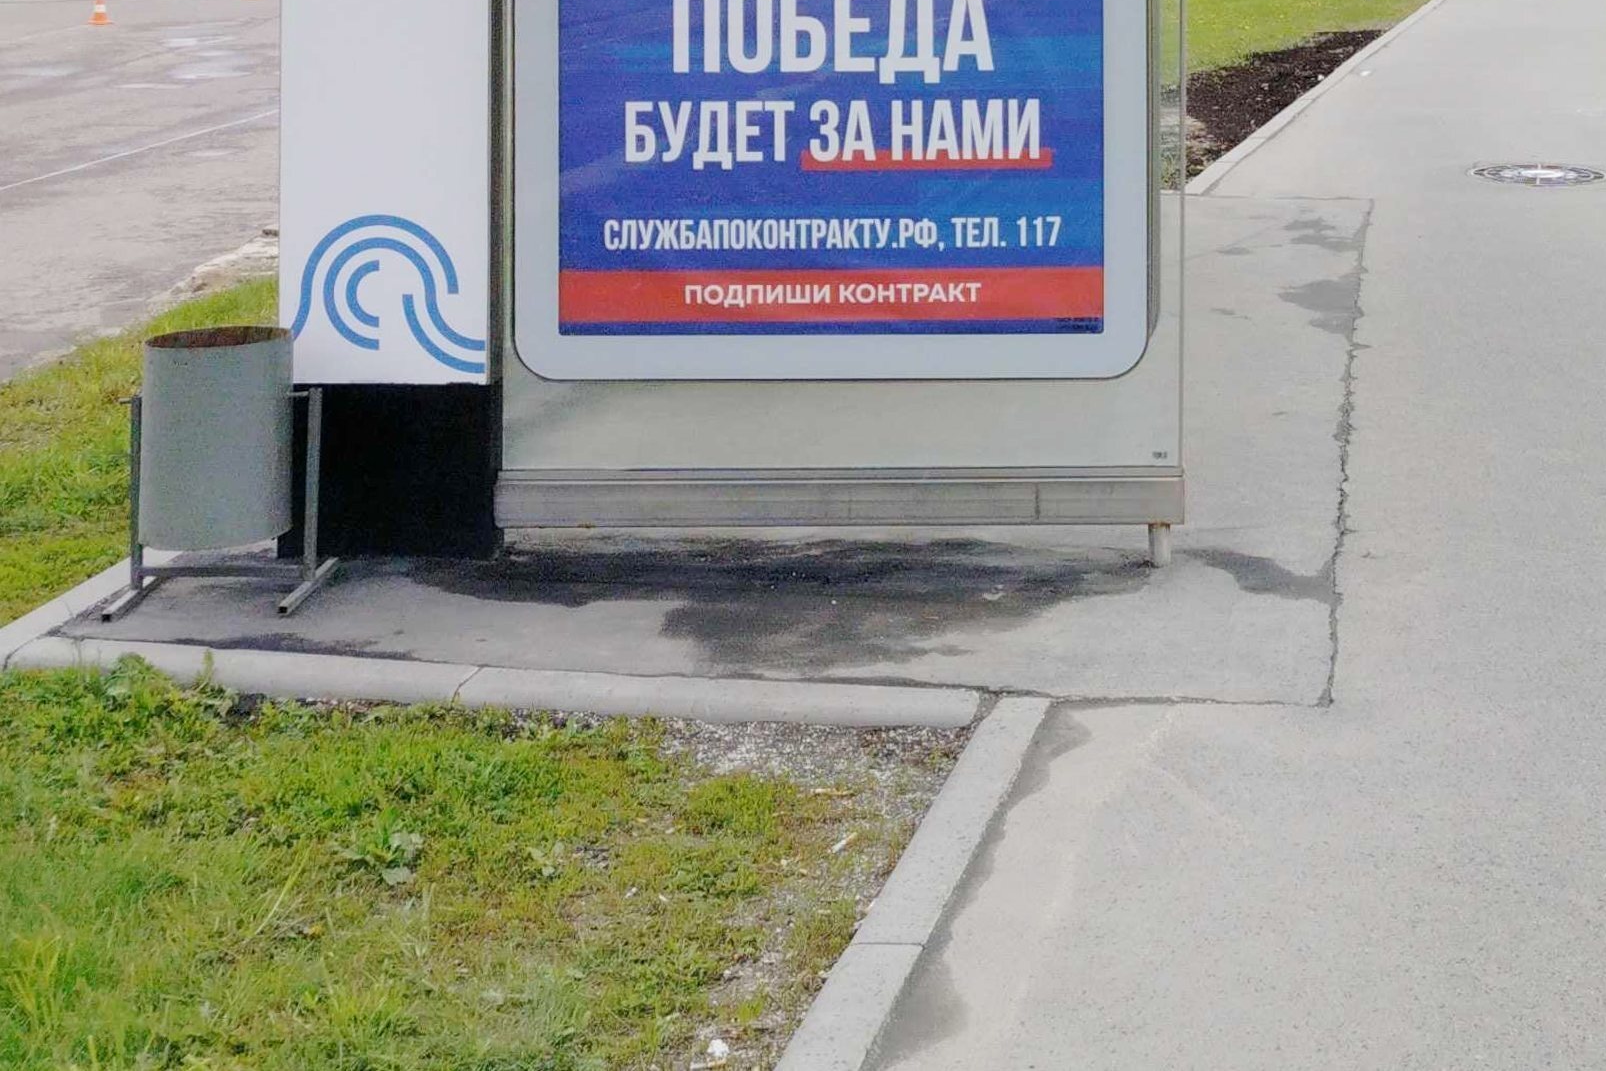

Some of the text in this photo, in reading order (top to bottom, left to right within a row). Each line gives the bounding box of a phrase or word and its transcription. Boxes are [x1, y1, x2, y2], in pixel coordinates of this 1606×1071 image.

[624, 98, 1042, 171] БУДЕТ ЗА НАМИ
[603, 215, 1062, 251] СЛУЖБАПОКОНТРАКТУ.РФ, ТЕЛ. 117
[684, 281, 982, 307] ПОДПИШИ КОНТРАКТ
